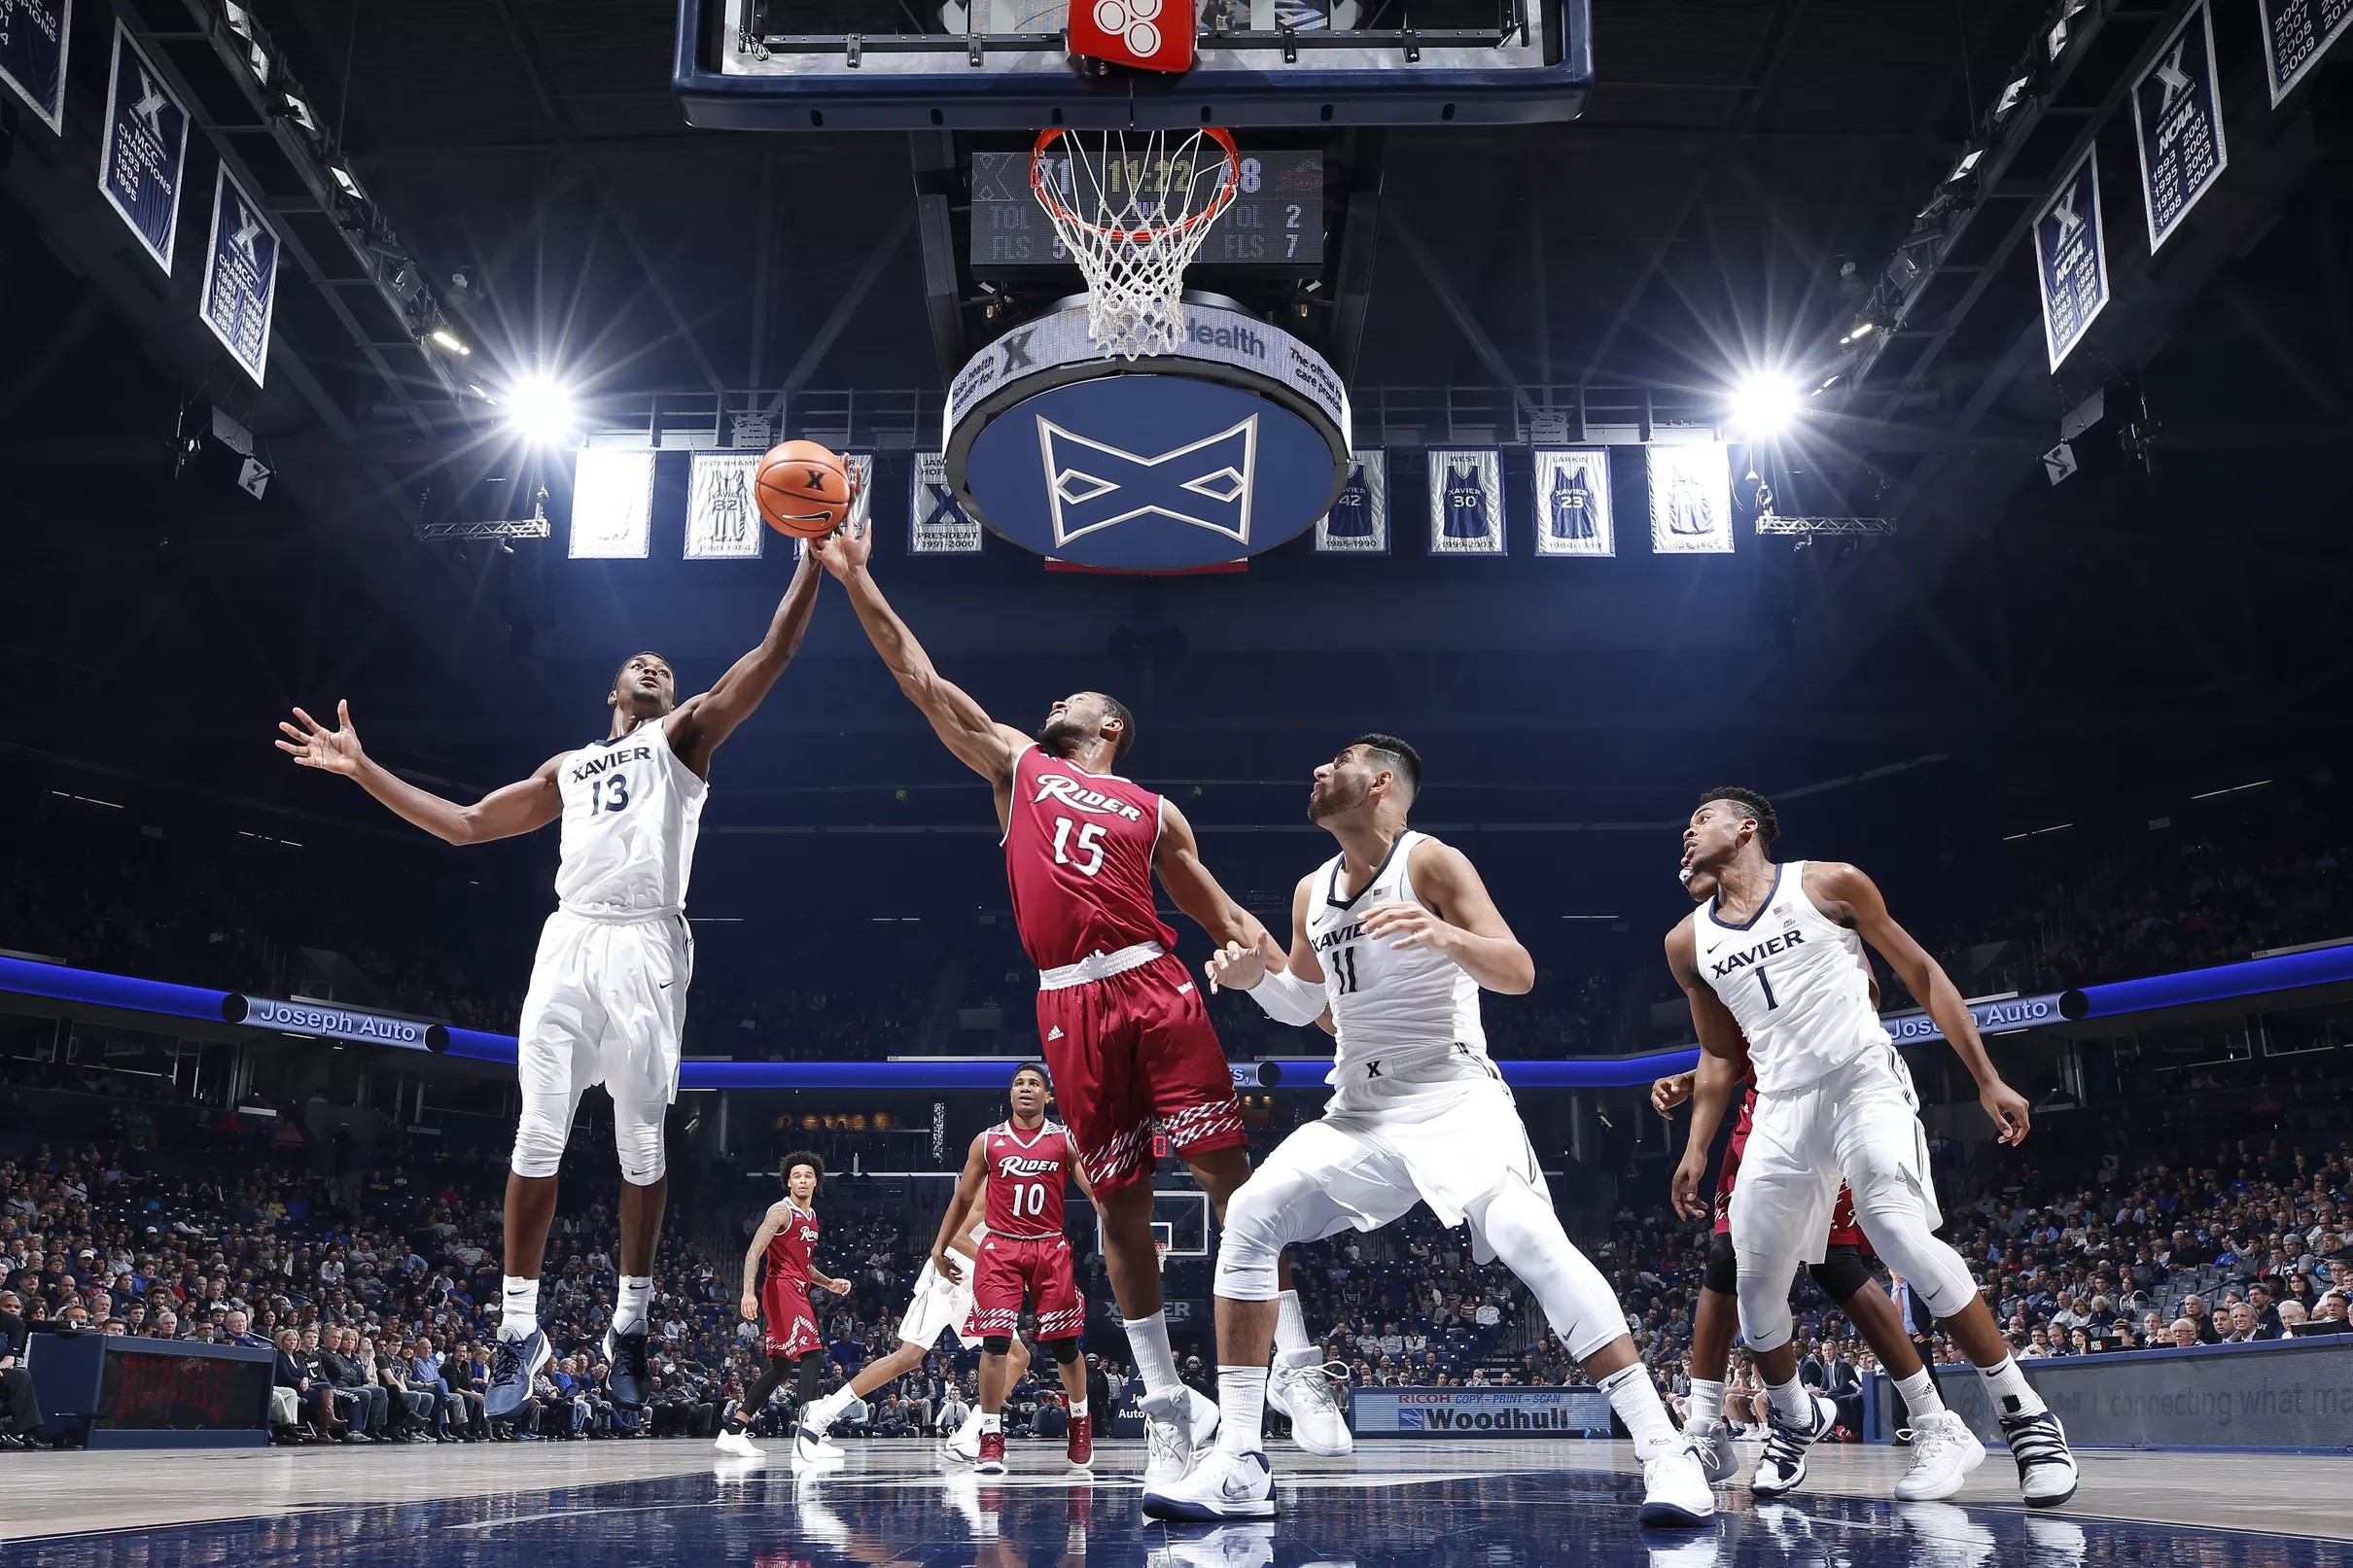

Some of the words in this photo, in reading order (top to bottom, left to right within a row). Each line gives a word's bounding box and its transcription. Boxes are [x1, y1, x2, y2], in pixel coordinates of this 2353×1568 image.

[20, 0, 56, 43] PIONS
[2275, 0, 2304, 33] 200
[2277, 1, 2309, 49] 2007
[2279, 19, 2313, 64] 2008
[2281, 36, 2315, 80] 2009
[2154, 39, 2191, 117] X
[133, 65, 168, 144] X
[2169, 82, 2196, 119] BASKETBALL
[134, 128, 158, 165] MCC
[2153, 149, 2176, 183] 1993
[2183, 111, 2205, 147] 2001
[2159, 99, 2195, 157] NCAA
[117, 154, 139, 188] 1994
[118, 138, 140, 173] 1993
[119, 122, 171, 195] CHAMPIONS
[2154, 163, 2178, 197] 1995
[2184, 124, 2209, 162] 2002
[116, 168, 137, 202] 1995
[1108, 159, 1191, 192] 11:22
[2156, 178, 2180, 213] 1997
[2186, 140, 2211, 178] 2003
[2159, 193, 2182, 227] 1998
[2188, 154, 2214, 193] 2004
[231, 195, 263, 265] X
[990, 205, 1030, 229] TOL
[1286, 204, 1301, 228] 2
[2052, 182, 2083, 252] X
[992, 235, 1030, 260] FLS
[1052, 235, 1067, 260] 5
[1225, 234, 1264, 259] FLS
[1285, 233, 1300, 259] 7
[2055, 238, 2084, 287] NCAA
[219, 253, 263, 315] CHAMPIONS
[233, 258, 254, 289] MCC
[2052, 282, 2069, 309] 1961
[2075, 248, 2094, 279] 1988
[2053, 295, 2072, 323] 1983
[2076, 261, 2095, 292] 1989
[216, 281, 236, 310] 1983
[242, 313, 261, 340] 1989
[218, 267, 236, 296] 1981
[243, 299, 262, 328] 1988
[2054, 310, 2074, 336] 1986
[2078, 277, 2096, 306] 1990
[212, 308, 232, 336] 1987
[237, 339, 257, 366] 1991
[214, 295, 234, 323] 1986
[240, 326, 259, 353] 1990
[2056, 323, 2075, 350] 1987
[2080, 291, 2097, 319] 1991
[1001, 327, 1037, 380] X
[1289, 346, 1309, 367] The
[1295, 367, 1317, 388] care
[805, 469, 827, 493] X
[1338, 494, 1362, 506] 42
[1448, 487, 1482, 496] XAVIER
[1555, 488, 1590, 498] XAVIER
[1454, 496, 1477, 508] 30
[1561, 496, 1585, 509] 23
[1441, 540, 1494, 549] 1999-2003
[572, 747, 651, 784] XAVIER
[591, 774, 629, 817] 13
[1053, 816, 1108, 877] 15
[1311, 921, 1367, 953] XAVIE
[1710, 929, 1806, 980] XAVIER
[1331, 946, 1357, 995] 11
[1755, 965, 1779, 1012] 1
[260, 1001, 353, 1034] Joseph
[358, 1016, 418, 1042] Auto
[1985, 999, 2049, 1026] Auto
[1366, 1060, 1385, 1079] X
[998, 1154, 1060, 1179] RIDER
[1012, 1182, 1046, 1217] 10
[1104, 1301, 1191, 1317] XER
[2090, 1340, 2102, 1351] POSS
[1118, 1409, 1145, 1419] Auto
[1398, 1394, 1451, 1404] RICOH
[1455, 1394, 1483, 1405] COPY
[1493, 1394, 1523, 1404] PRINT
[1532, 1394, 1562, 1404] SCAN
[2110, 1381, 2232, 1427] connecting
[2238, 1376, 2303, 1416] what
[1425, 1408, 1569, 1431] Woodhull
